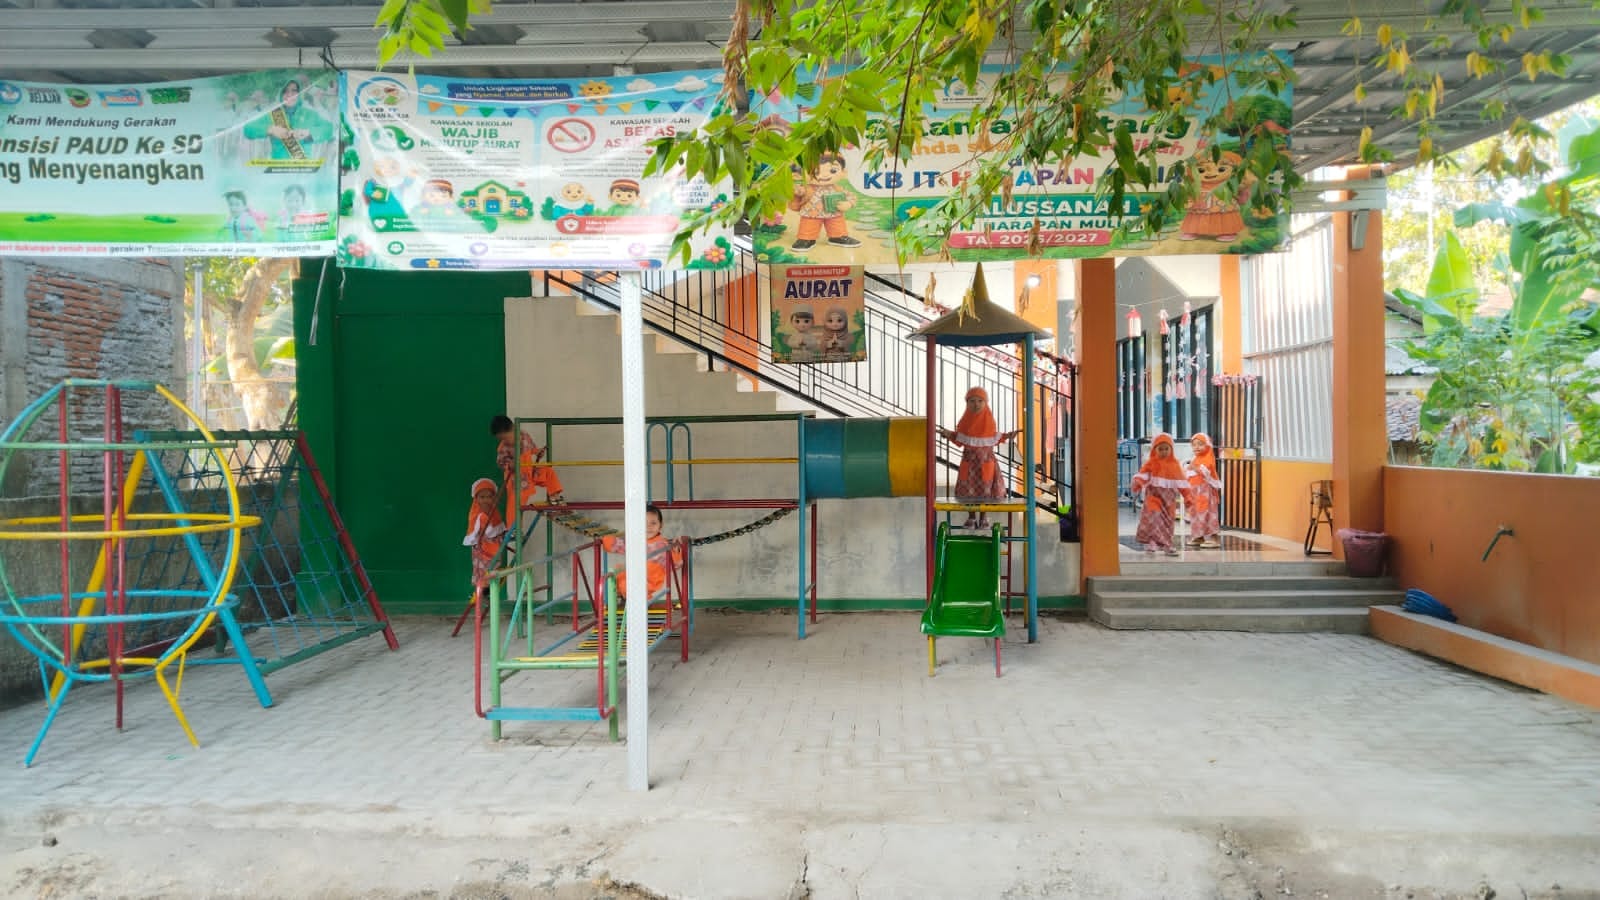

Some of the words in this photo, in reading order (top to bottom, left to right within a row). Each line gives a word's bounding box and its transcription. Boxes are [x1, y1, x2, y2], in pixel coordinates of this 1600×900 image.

[6, 114, 42, 126] Kami
[45, 116, 120, 130] Mendukung
[123, 117, 177, 127] Gerakan
[441, 127, 499, 139] WAJIB
[0, 135, 60, 154] nsisi
[65, 136, 129, 155] PAUD
[136, 136, 165, 154] Ke
[172, 134, 204, 154] SD
[29, 157, 205, 185] Menyenangkan
[863, 171, 904, 190] KB
[913, 170, 941, 188] IT
[951, 168, 1094, 187] HAPAN
[784, 279, 853, 299] AURAT
